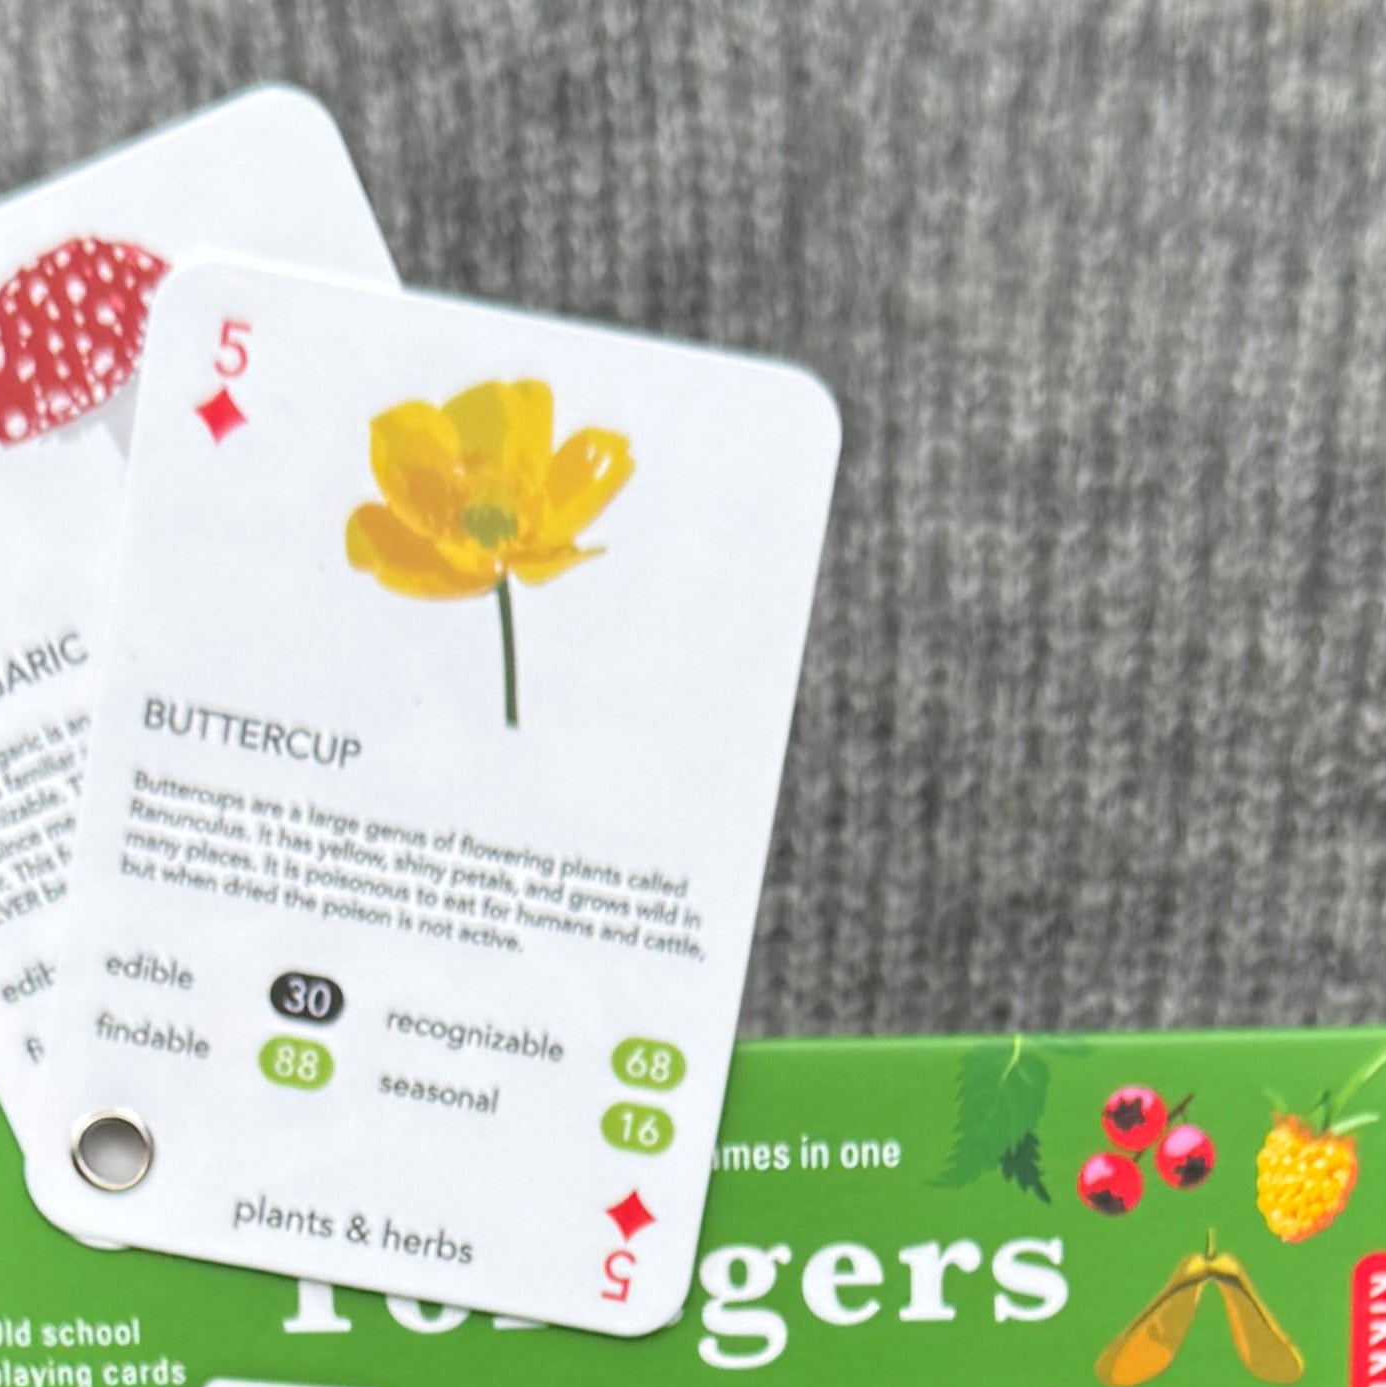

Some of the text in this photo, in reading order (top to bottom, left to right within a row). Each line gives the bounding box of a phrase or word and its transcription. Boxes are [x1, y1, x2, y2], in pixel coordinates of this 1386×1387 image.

[214, 319, 249, 378] 5
[143, 697, 362, 769] BUTTERCUP
[129, 797, 702, 929] Ranunculus. It has yellow, shiny petals, and grows wild in
[132, 769, 689, 898] Buttercups are a large genus of flowering plants called
[120, 853, 524, 952] but when dried the poison is not active.
[124, 831, 705, 962] many places. It is poisonous to eat for humans and cattle,
[106, 953, 332, 1018] edible 30
[96, 1011, 319, 1081] findable 88
[387, 1011, 671, 1083] recognizable 68
[379, 1075, 659, 1147] seasonal 16
[801, 1135, 829, 1168] in
[840, 1140, 901, 1168] one
[233, 1195, 472, 1264] plants & herbs
[281, 1236, 1069, 1369] gers
[601, 1250, 635, 1303] 5
[41, 1318, 140, 1347] school
[102, 1357, 186, 1386] cards
